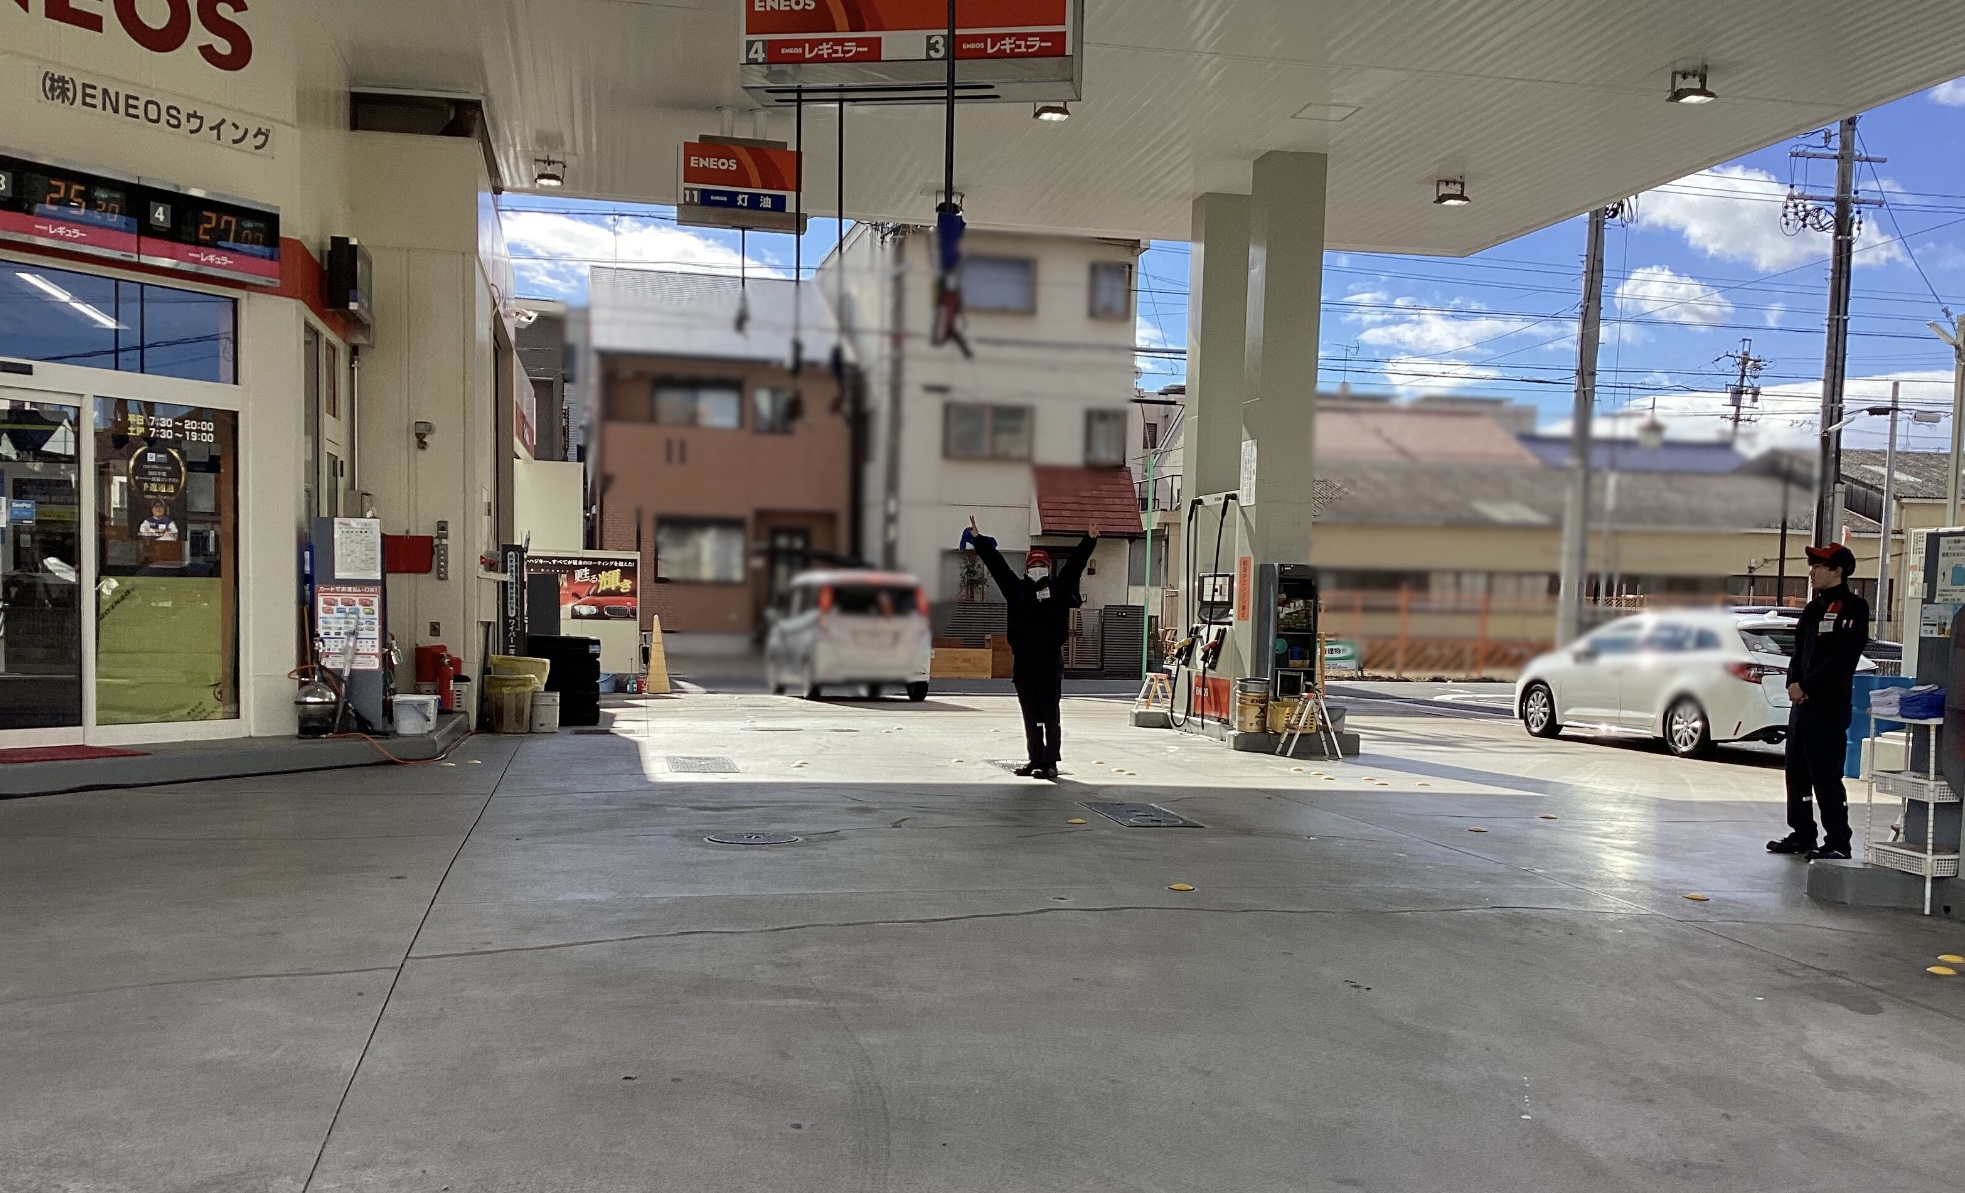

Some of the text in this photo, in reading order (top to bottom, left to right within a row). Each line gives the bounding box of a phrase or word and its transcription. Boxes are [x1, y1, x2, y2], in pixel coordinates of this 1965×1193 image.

[748, 41, 765, 63] 4
[804, 42, 868, 59] レギュラー
[929, 35, 945, 59] 3
[986, 36, 1052, 54] レギュラー
[42, 70, 271, 151] (株)ENEOSウイング
[690, 156, 737, 171] ENEOS
[684, 189, 698, 203] 11
[154, 206, 165, 222] 4
[1195, 686, 1209, 697] ENOS
